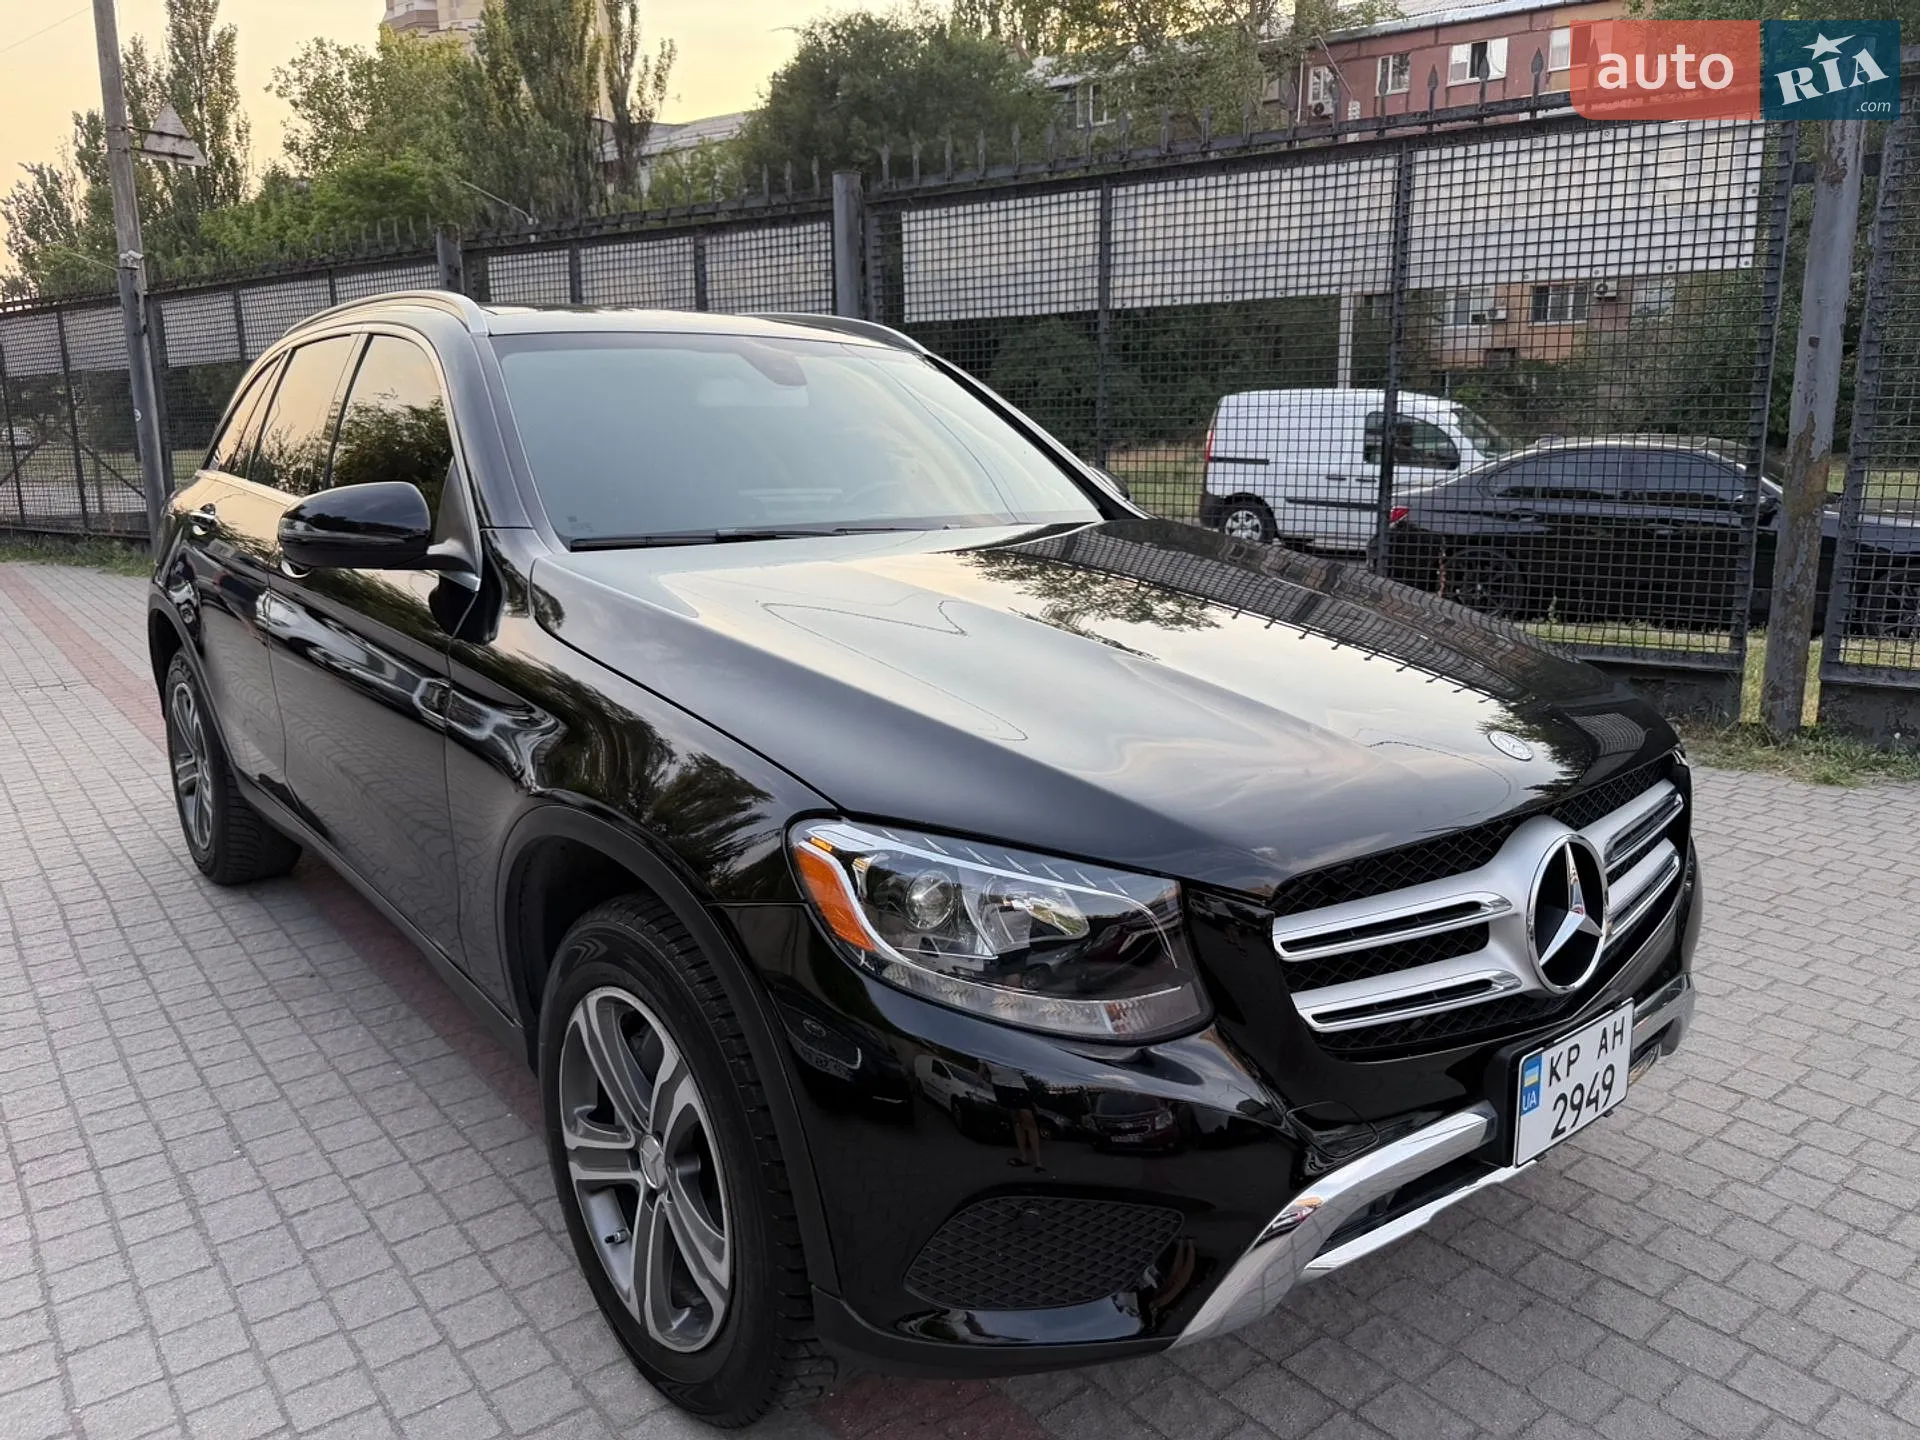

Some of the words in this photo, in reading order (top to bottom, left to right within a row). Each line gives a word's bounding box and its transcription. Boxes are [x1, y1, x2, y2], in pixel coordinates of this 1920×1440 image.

[1548, 1043, 1581, 1087] KP
[1597, 1016, 1626, 1059] AH
[1522, 1093, 1537, 1111] UA
[1551, 1063, 1616, 1140] 2949
